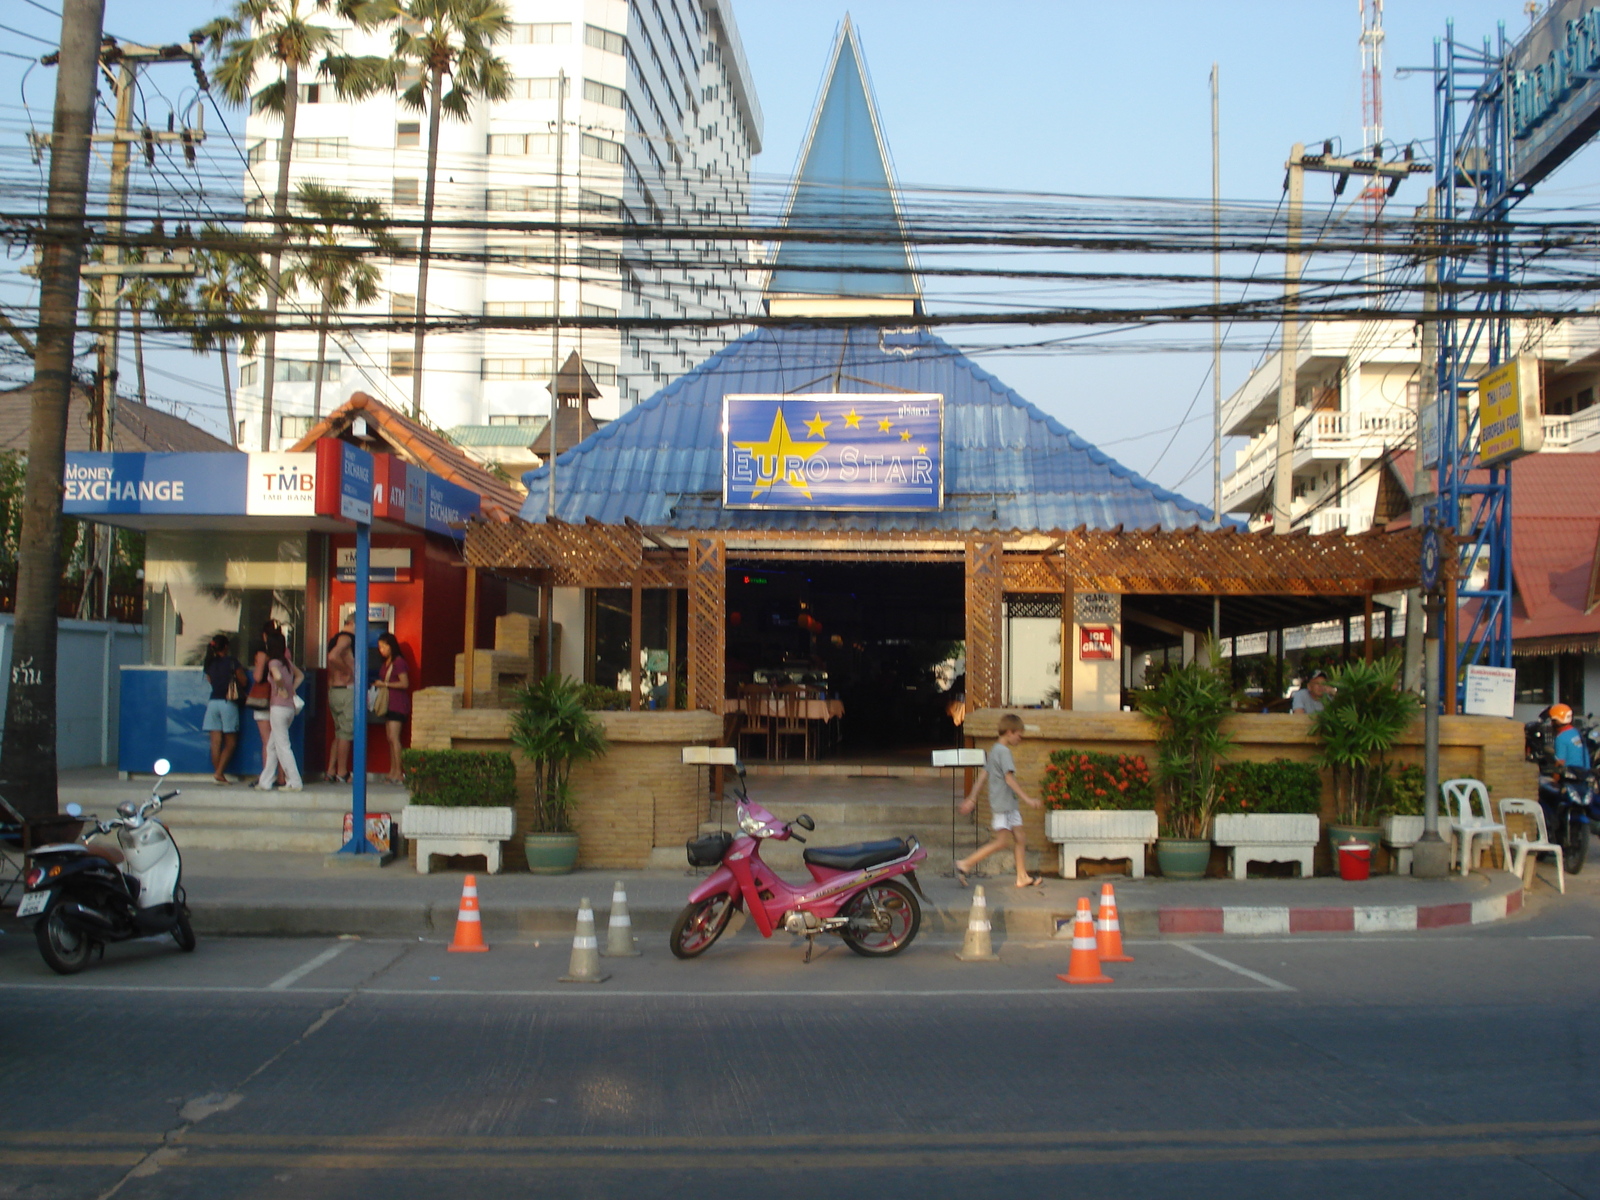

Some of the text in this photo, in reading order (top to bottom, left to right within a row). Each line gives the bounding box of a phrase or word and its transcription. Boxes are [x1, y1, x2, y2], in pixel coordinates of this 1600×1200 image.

[1507, 413, 1519, 431] FOOD
[65, 463, 114, 480] MONEY
[345, 460, 369, 483] EXCHANGE
[731, 445, 933, 485] EURO STAR
[263, 466, 314, 491] TMB
[64, 480, 184, 501] EXCHANGE
[287, 494, 313, 502] BANK
[390, 486, 405, 508] ATM
[430, 502, 459, 524] EXCHANGE
[1082, 642, 1111, 652] CREAM
[1089, 632, 1105, 641] ICE
